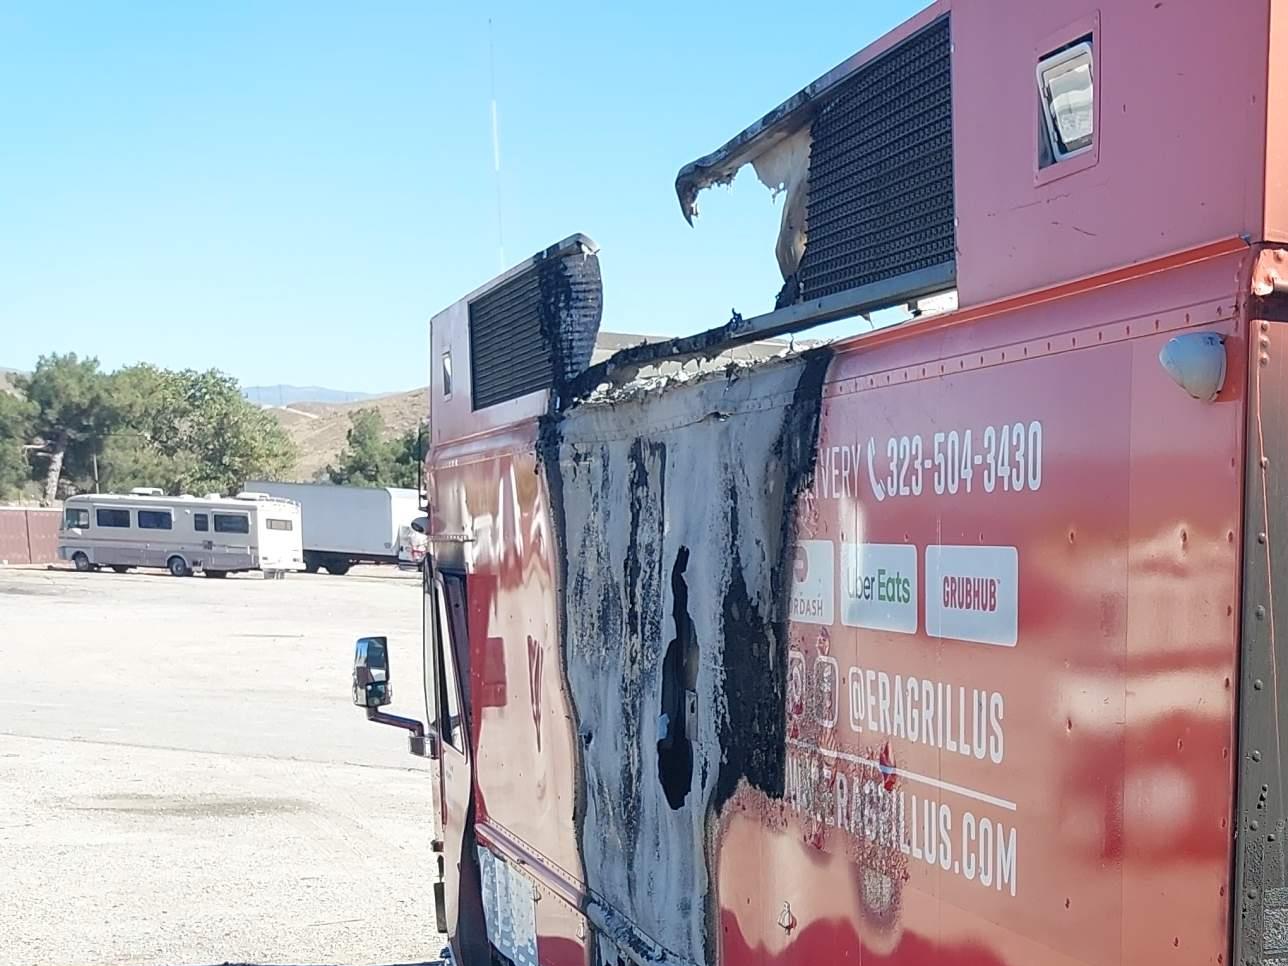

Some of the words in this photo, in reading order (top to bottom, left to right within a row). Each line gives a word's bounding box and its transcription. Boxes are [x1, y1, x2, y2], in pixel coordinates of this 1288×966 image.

[887, 420, 1043, 497] 323-504-3430
[847, 568, 875, 600] Uber
[878, 569, 911, 604] Eats
[943, 576, 997, 612] GRUBHUB
[790, 598, 823, 617] RDASH
[849, 666, 1004, 764] @ERAGRILLUS
